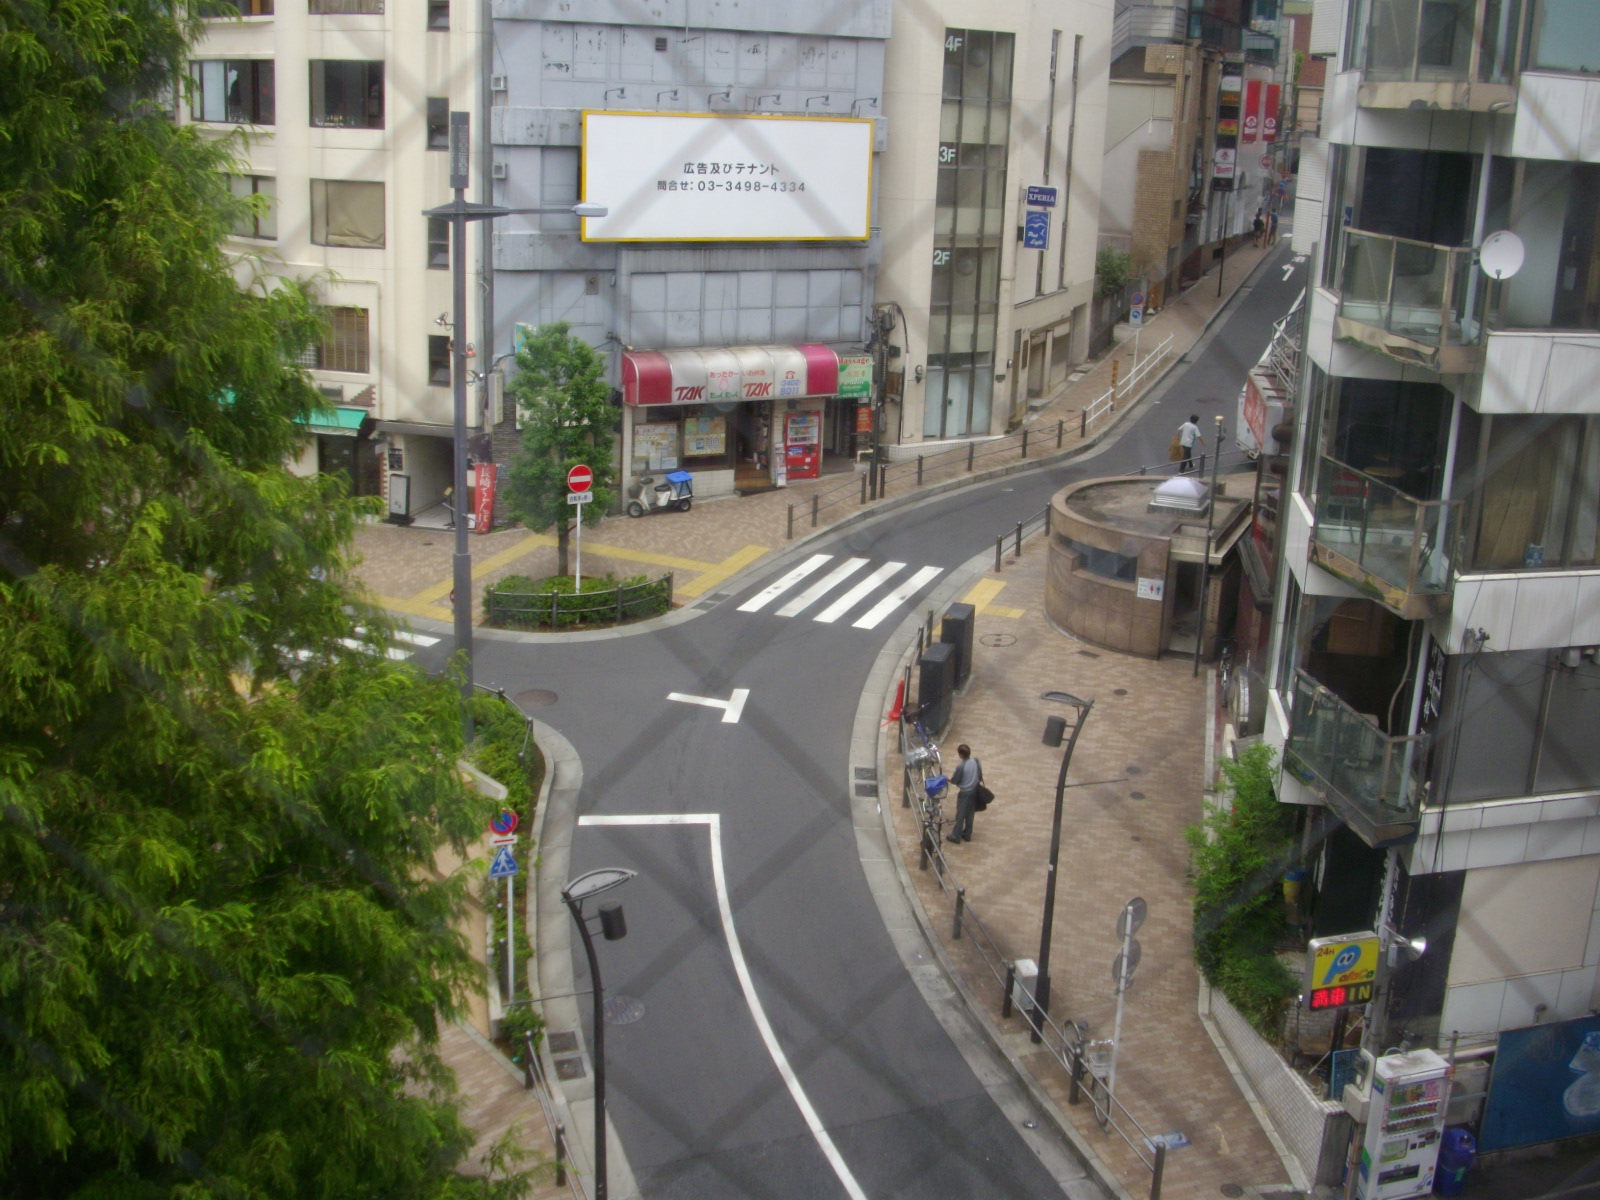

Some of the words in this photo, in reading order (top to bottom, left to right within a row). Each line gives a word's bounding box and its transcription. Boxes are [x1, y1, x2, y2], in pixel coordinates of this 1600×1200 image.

[945, 36, 962, 51] 4F
[939, 146, 956, 162] 3F
[683, 162, 779, 175] 広告及びテナント
[1028, 193, 1055, 203] XPERIA
[933, 250, 950, 265] 2F
[675, 386, 705, 401] TAK
[743, 382, 772, 397] TAK
[1349, 985, 1371, 1002] IN
